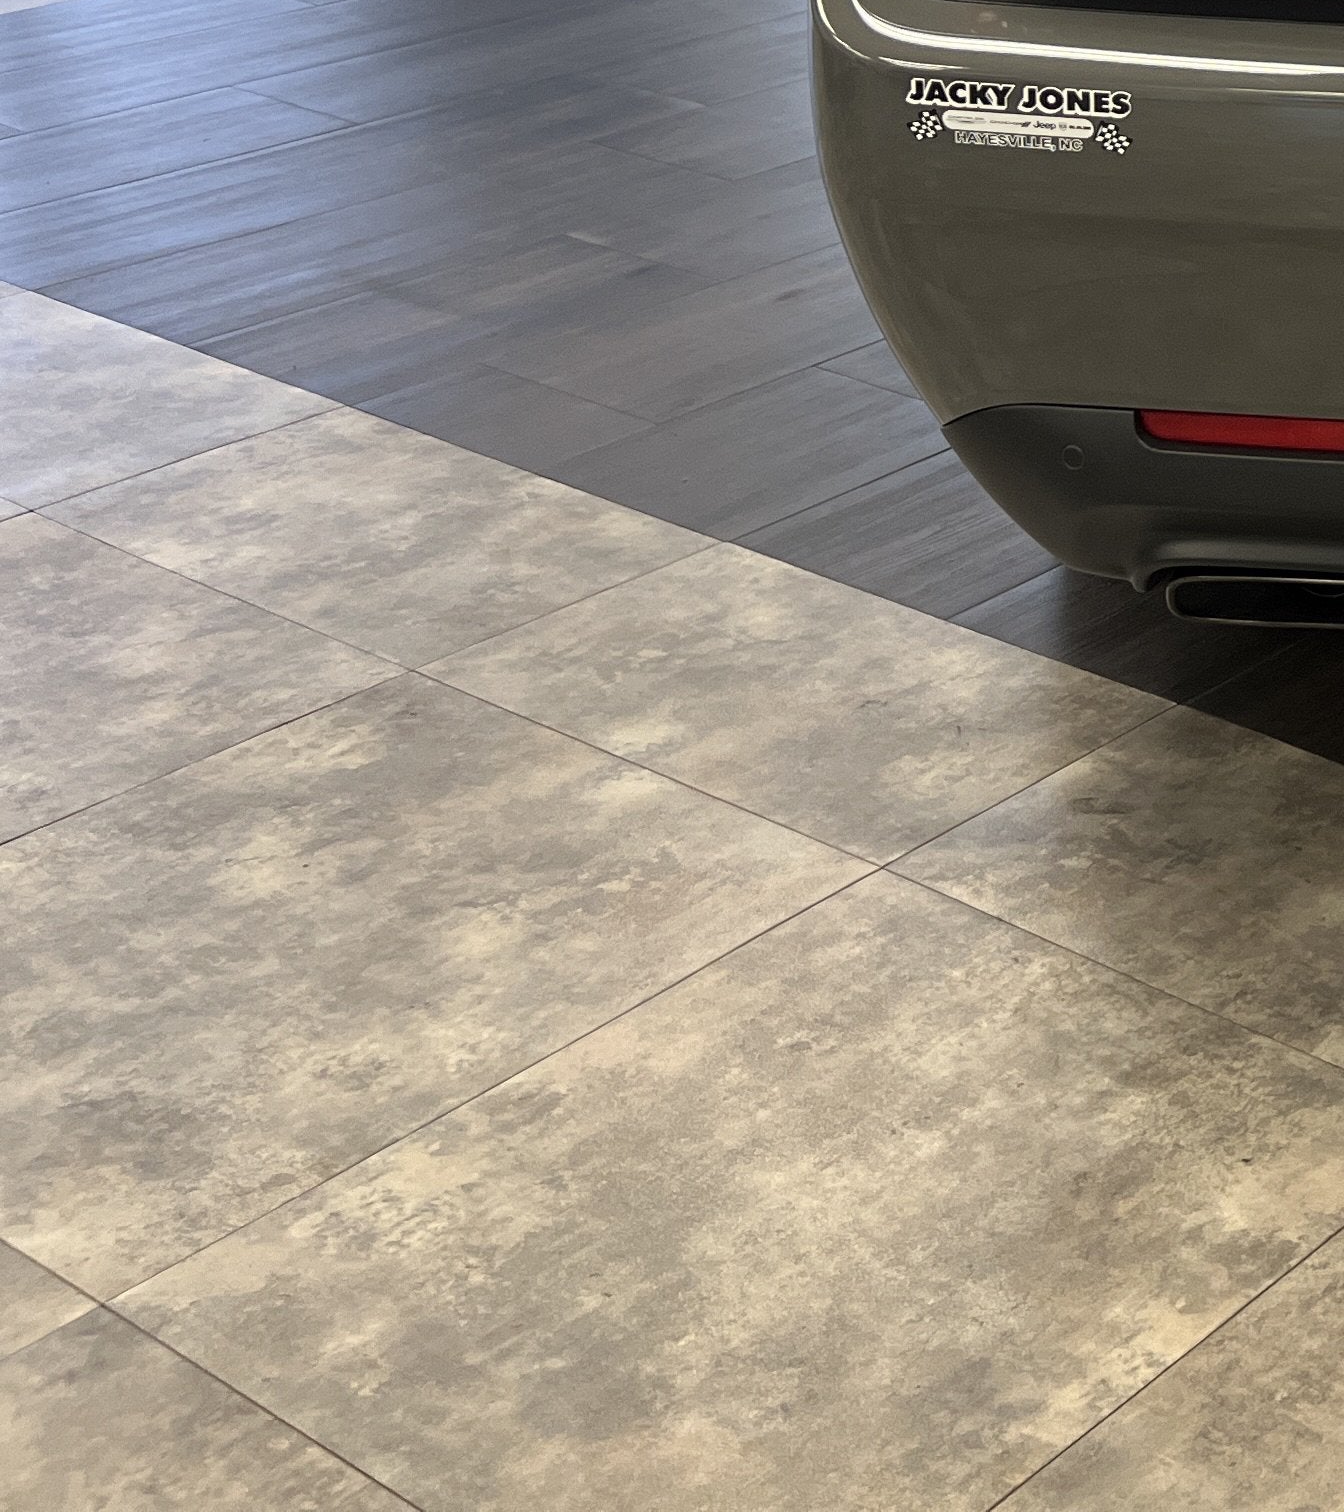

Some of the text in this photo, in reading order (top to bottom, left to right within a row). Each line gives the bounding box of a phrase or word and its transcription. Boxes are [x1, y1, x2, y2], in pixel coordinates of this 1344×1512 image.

[906, 78, 1132, 119] JACKY JONES
[1033, 120, 1057, 130] Jeep
[954, 131, 1084, 152] HAYESVILLE, NC
